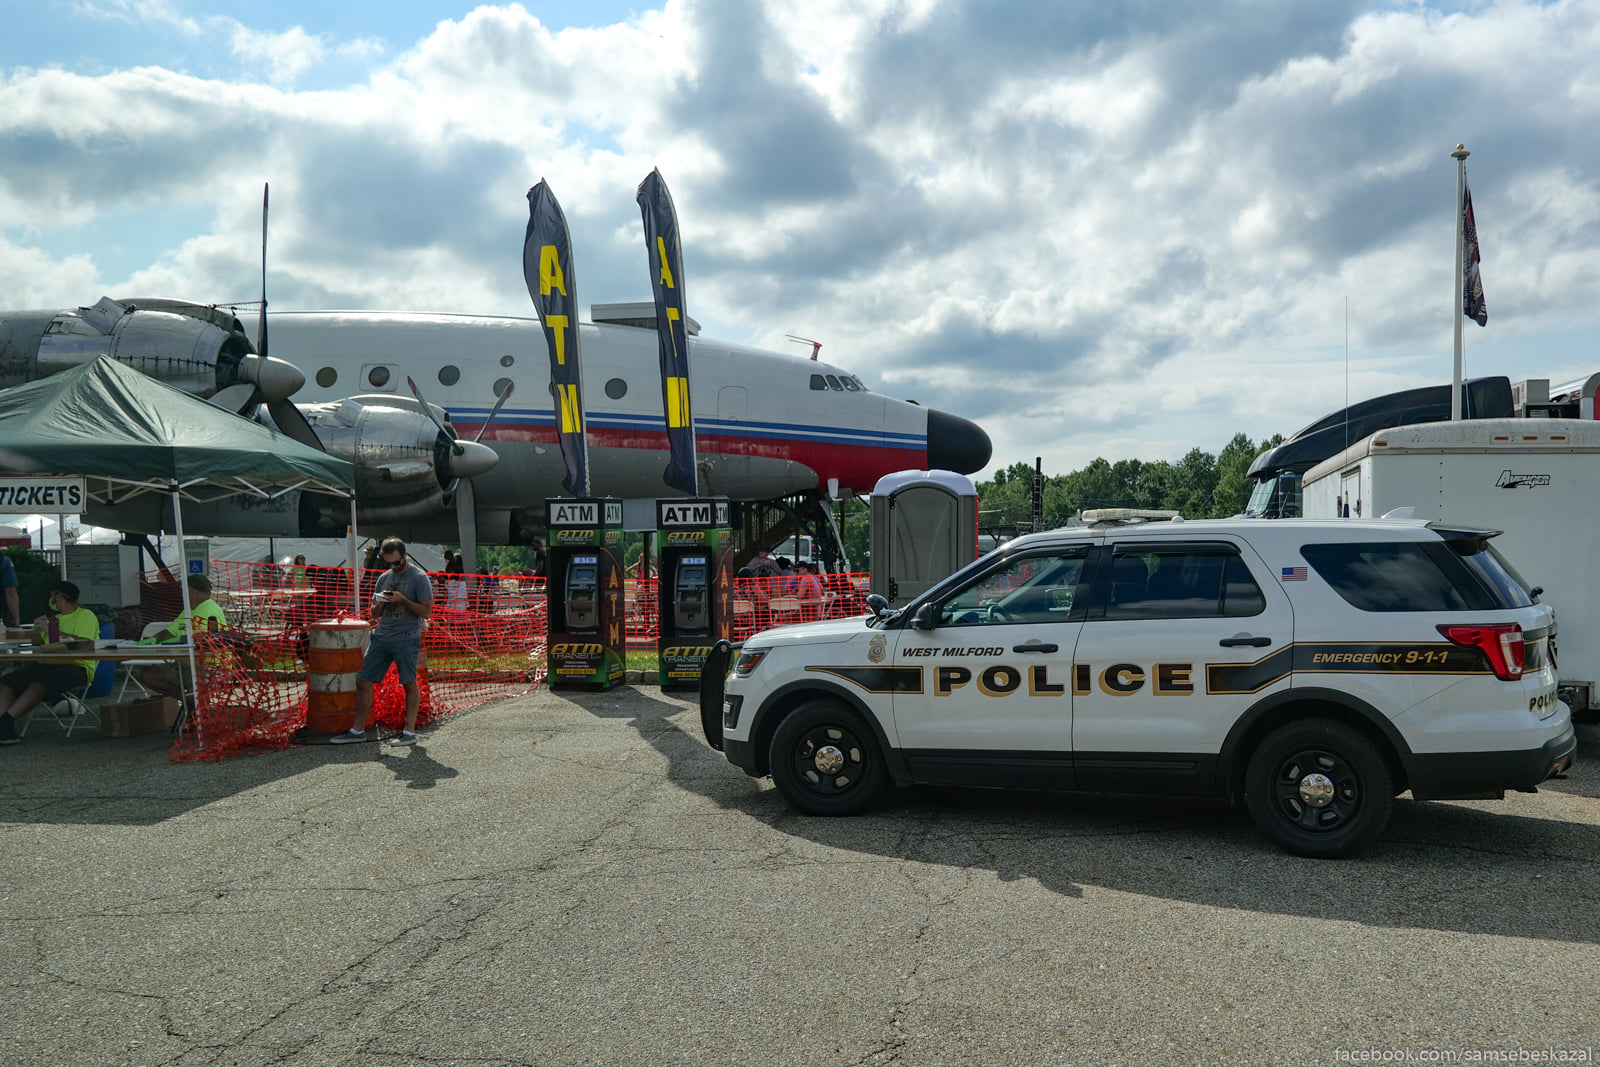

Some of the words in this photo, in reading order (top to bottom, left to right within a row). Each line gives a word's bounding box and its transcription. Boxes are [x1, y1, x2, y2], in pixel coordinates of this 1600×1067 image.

[539, 245, 581, 434] ATM
[0, 485, 81, 506] TICKETS
[556, 505, 593, 522] ATM
[606, 505, 620, 521] ATM
[664, 506, 709, 523] ATM
[556, 529, 594, 538] ATM
[667, 531, 705, 540] ATM
[609, 564, 620, 647] ATM
[551, 643, 603, 653] ATM
[903, 647, 941, 657] WEST
[942, 647, 1004, 657] MILFORD
[1312, 653, 1402, 664] EMERGENCY
[1405, 650, 1449, 664] 9-1-1
[933, 663, 1195, 698] POLICE
